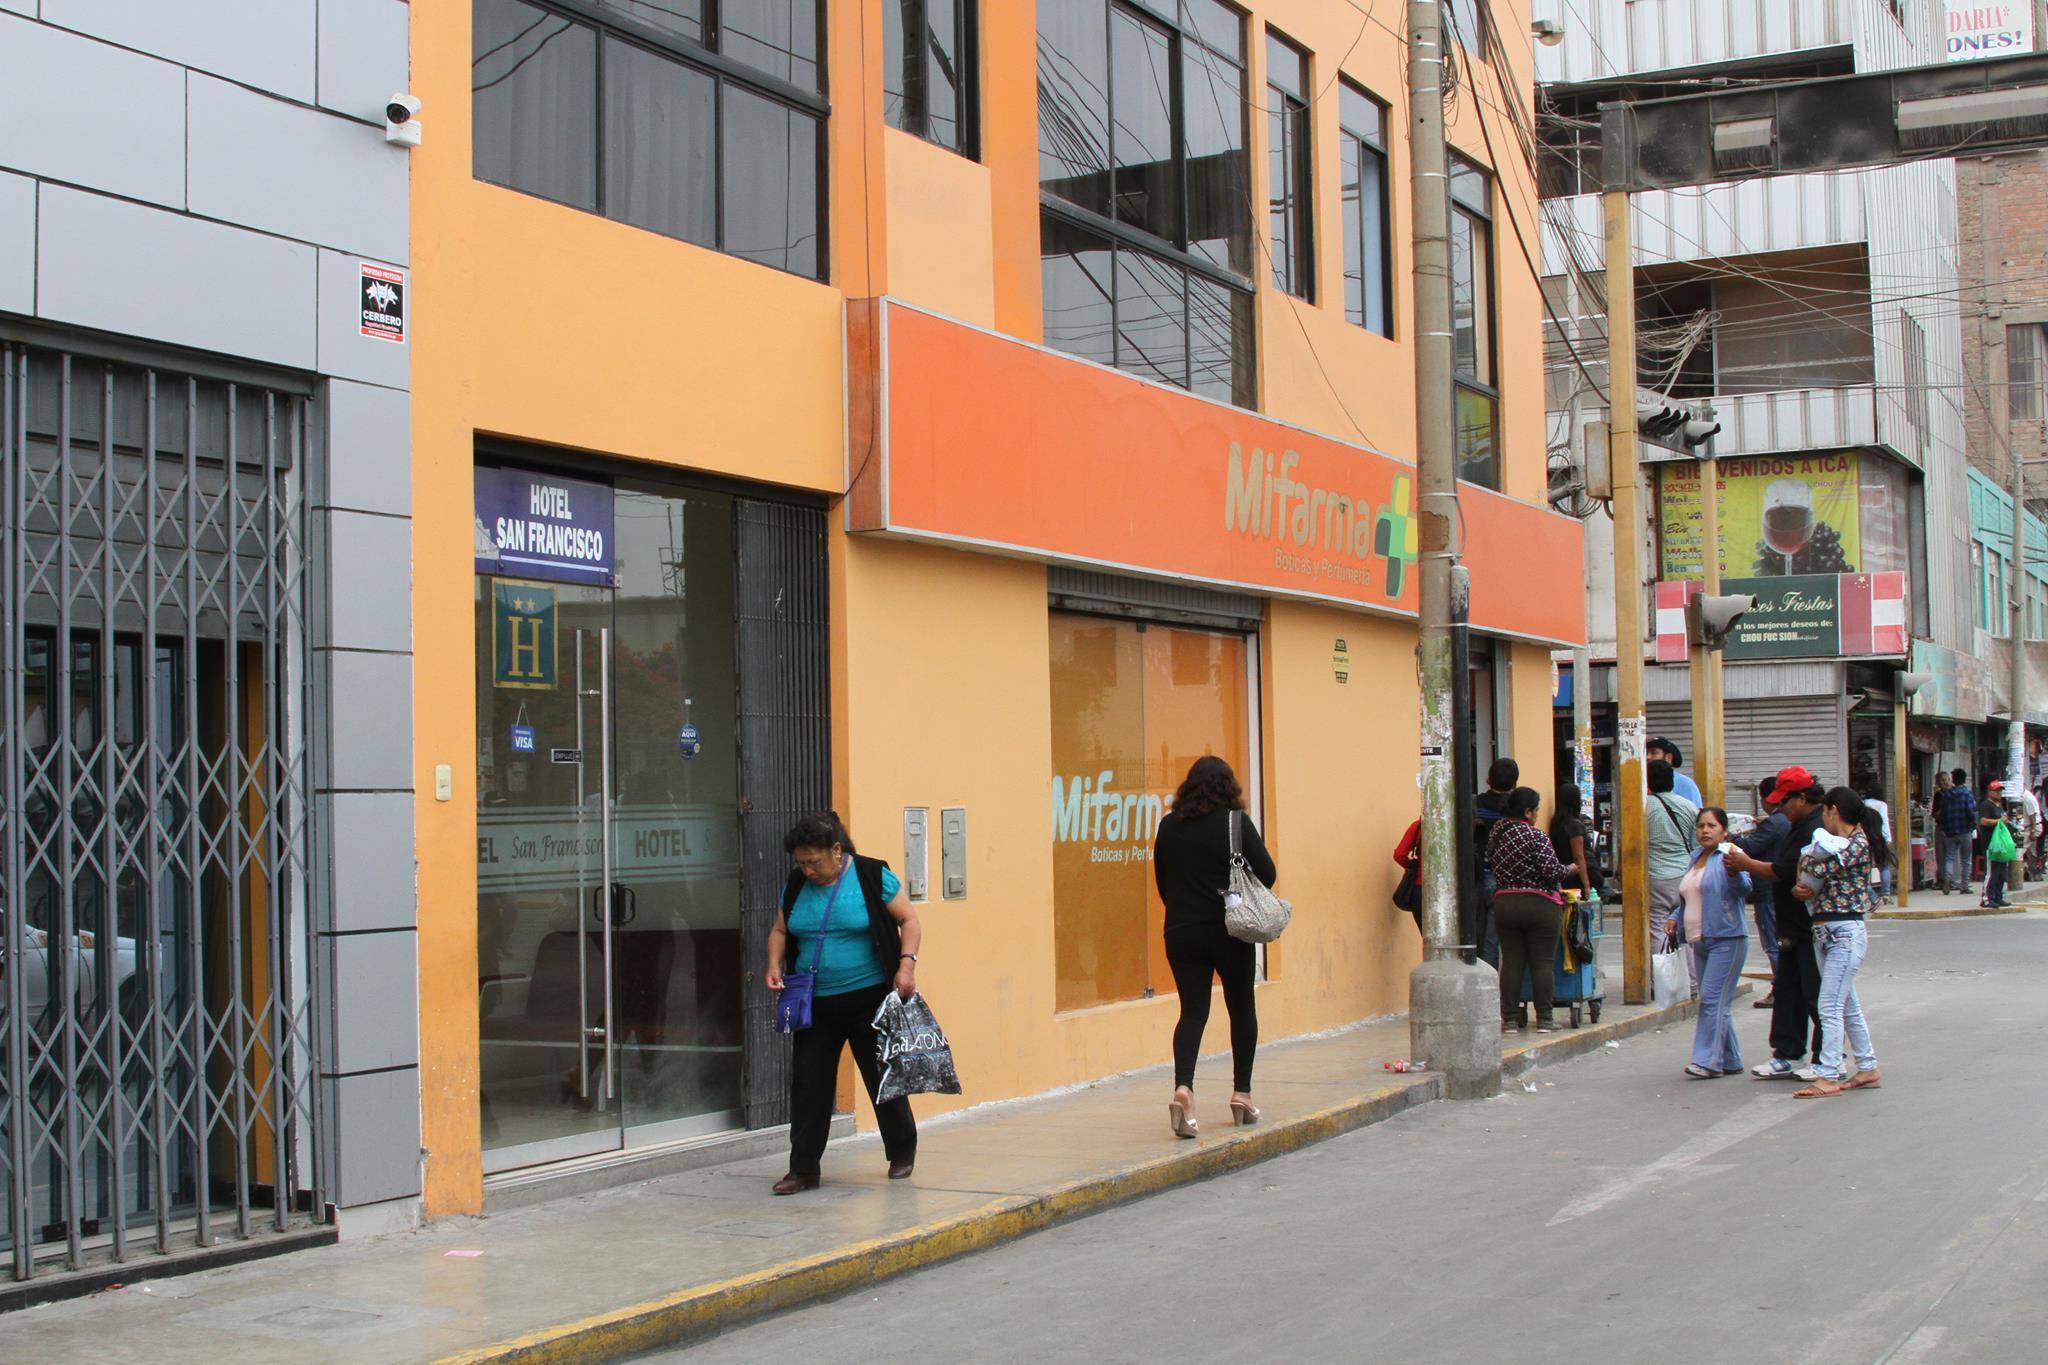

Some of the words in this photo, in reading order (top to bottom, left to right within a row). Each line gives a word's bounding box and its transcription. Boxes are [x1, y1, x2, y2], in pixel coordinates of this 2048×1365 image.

[363, 309, 402, 327] CERBERO
[1674, 459, 1794, 481] BIEVENIDOS
[1800, 459, 1813, 475] A
[1818, 455, 1849, 473] ICA
[530, 483, 573, 520] HOTEL
[1225, 440, 1371, 560] Mifarma
[496, 516, 525, 551] SAN
[528, 521, 603, 562] FRANCISCO
[1274, 547, 1312, 575] Boticas
[1778, 591, 1835, 613] Fiestas
[1740, 632, 1762, 643] CHOU
[1763, 632, 1778, 642] FUC
[1743, 622, 1756, 630] los
[1757, 621, 1789, 631] mejores
[1791, 620, 1819, 629] deseos
[1820, 619, 1833, 627] de:
[507, 615, 544, 678] H
[515, 735, 534, 749] VISA
[511, 835, 538, 860] San
[635, 828, 692, 858] HOTEL
[1091, 846, 1123, 862] Boticas
[1124, 849, 1130, 864] y
